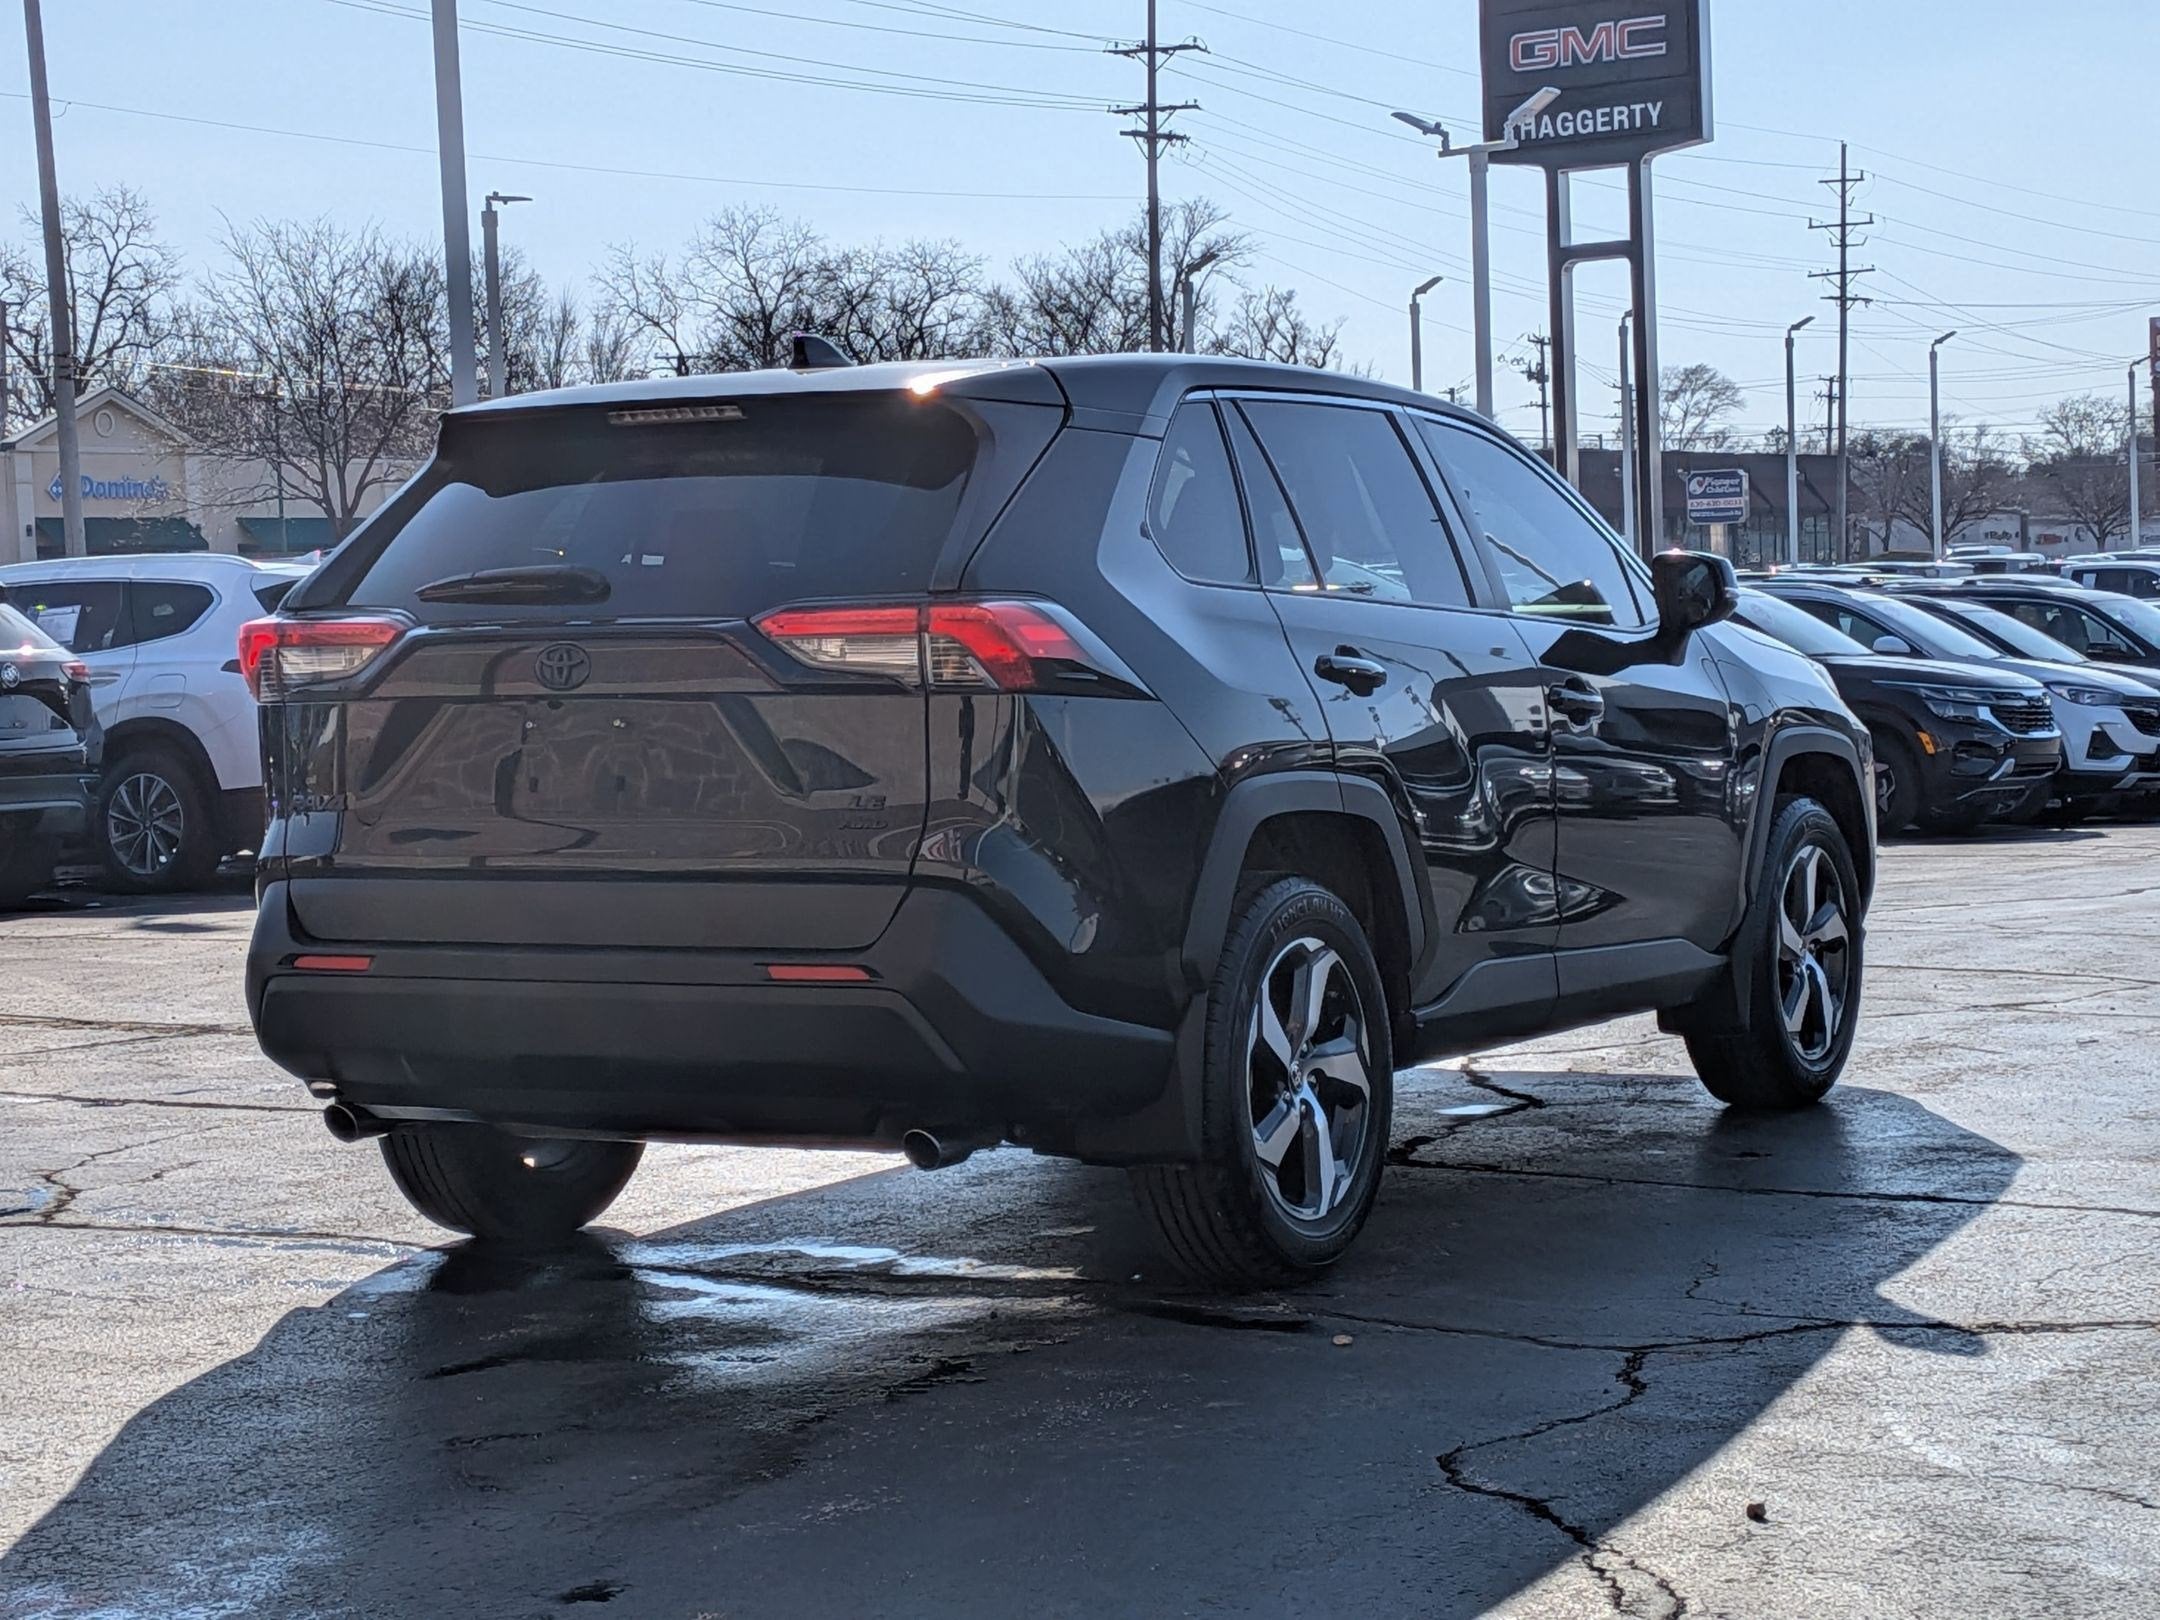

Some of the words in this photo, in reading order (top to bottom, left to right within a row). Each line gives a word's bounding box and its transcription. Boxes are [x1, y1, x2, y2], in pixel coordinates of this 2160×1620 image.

[1510, 15, 1666, 72] GMC
[1517, 101, 1663, 141] HAGGERTY
[81, 475, 168, 499] Domino's
